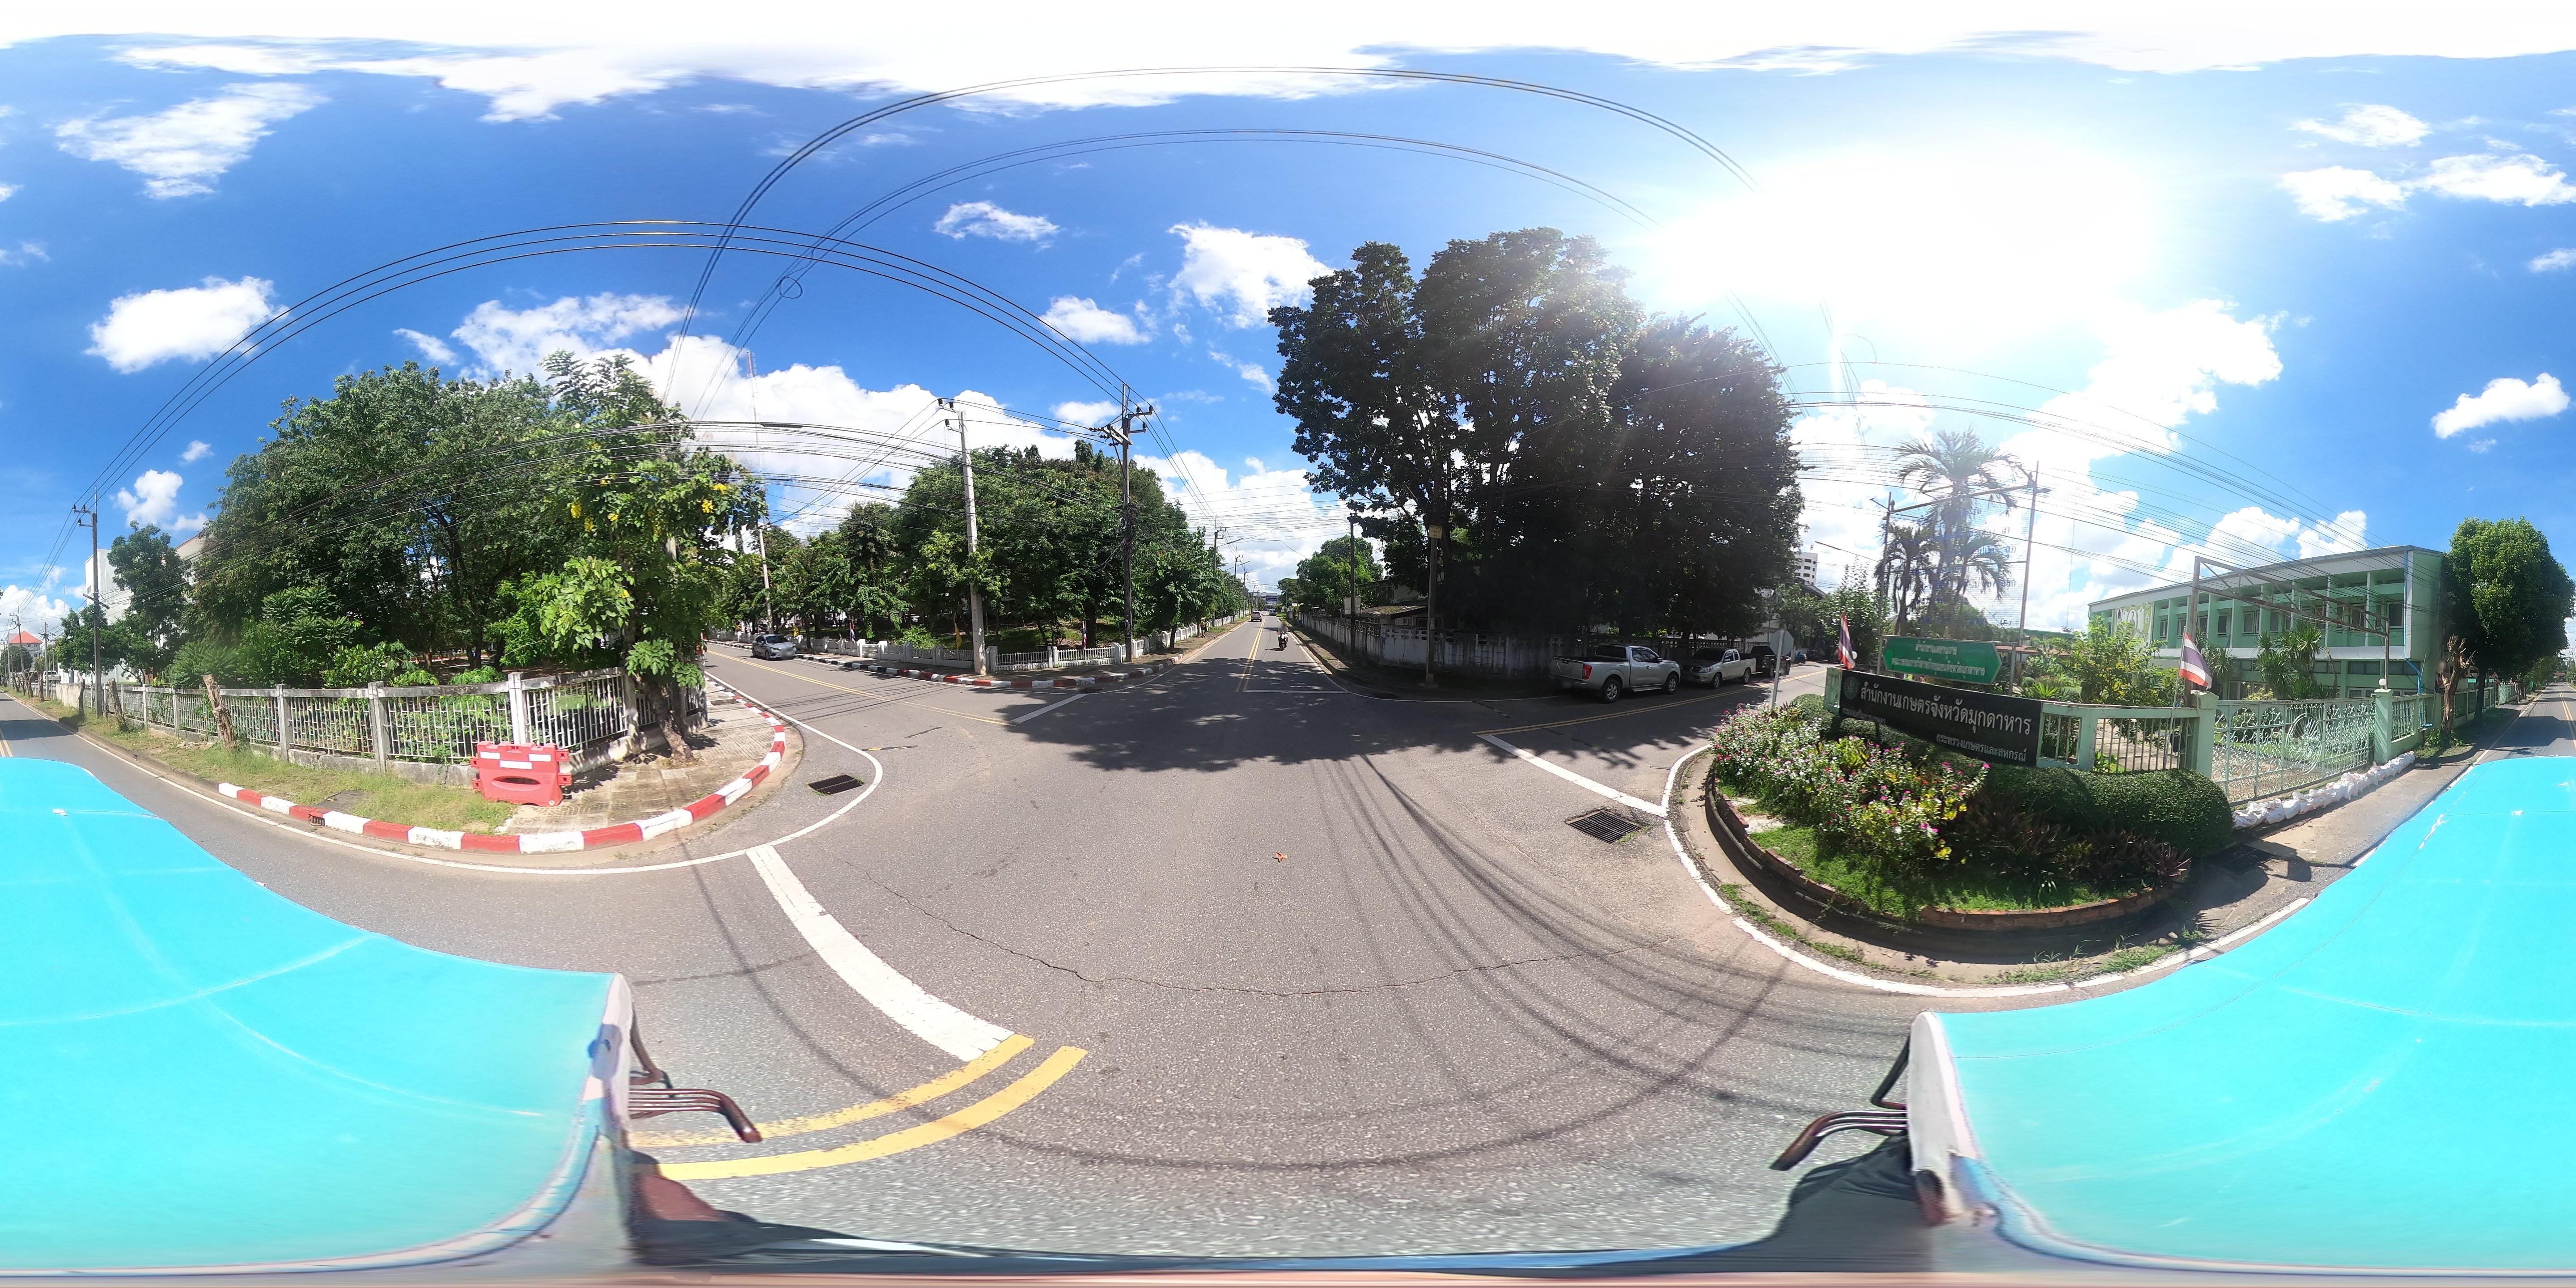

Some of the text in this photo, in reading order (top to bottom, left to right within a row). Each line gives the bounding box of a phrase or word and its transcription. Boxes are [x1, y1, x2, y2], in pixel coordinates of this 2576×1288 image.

[1860, 681, 2032, 735] สำนักงานเกษตรจังหวัดมุกดาหาร
